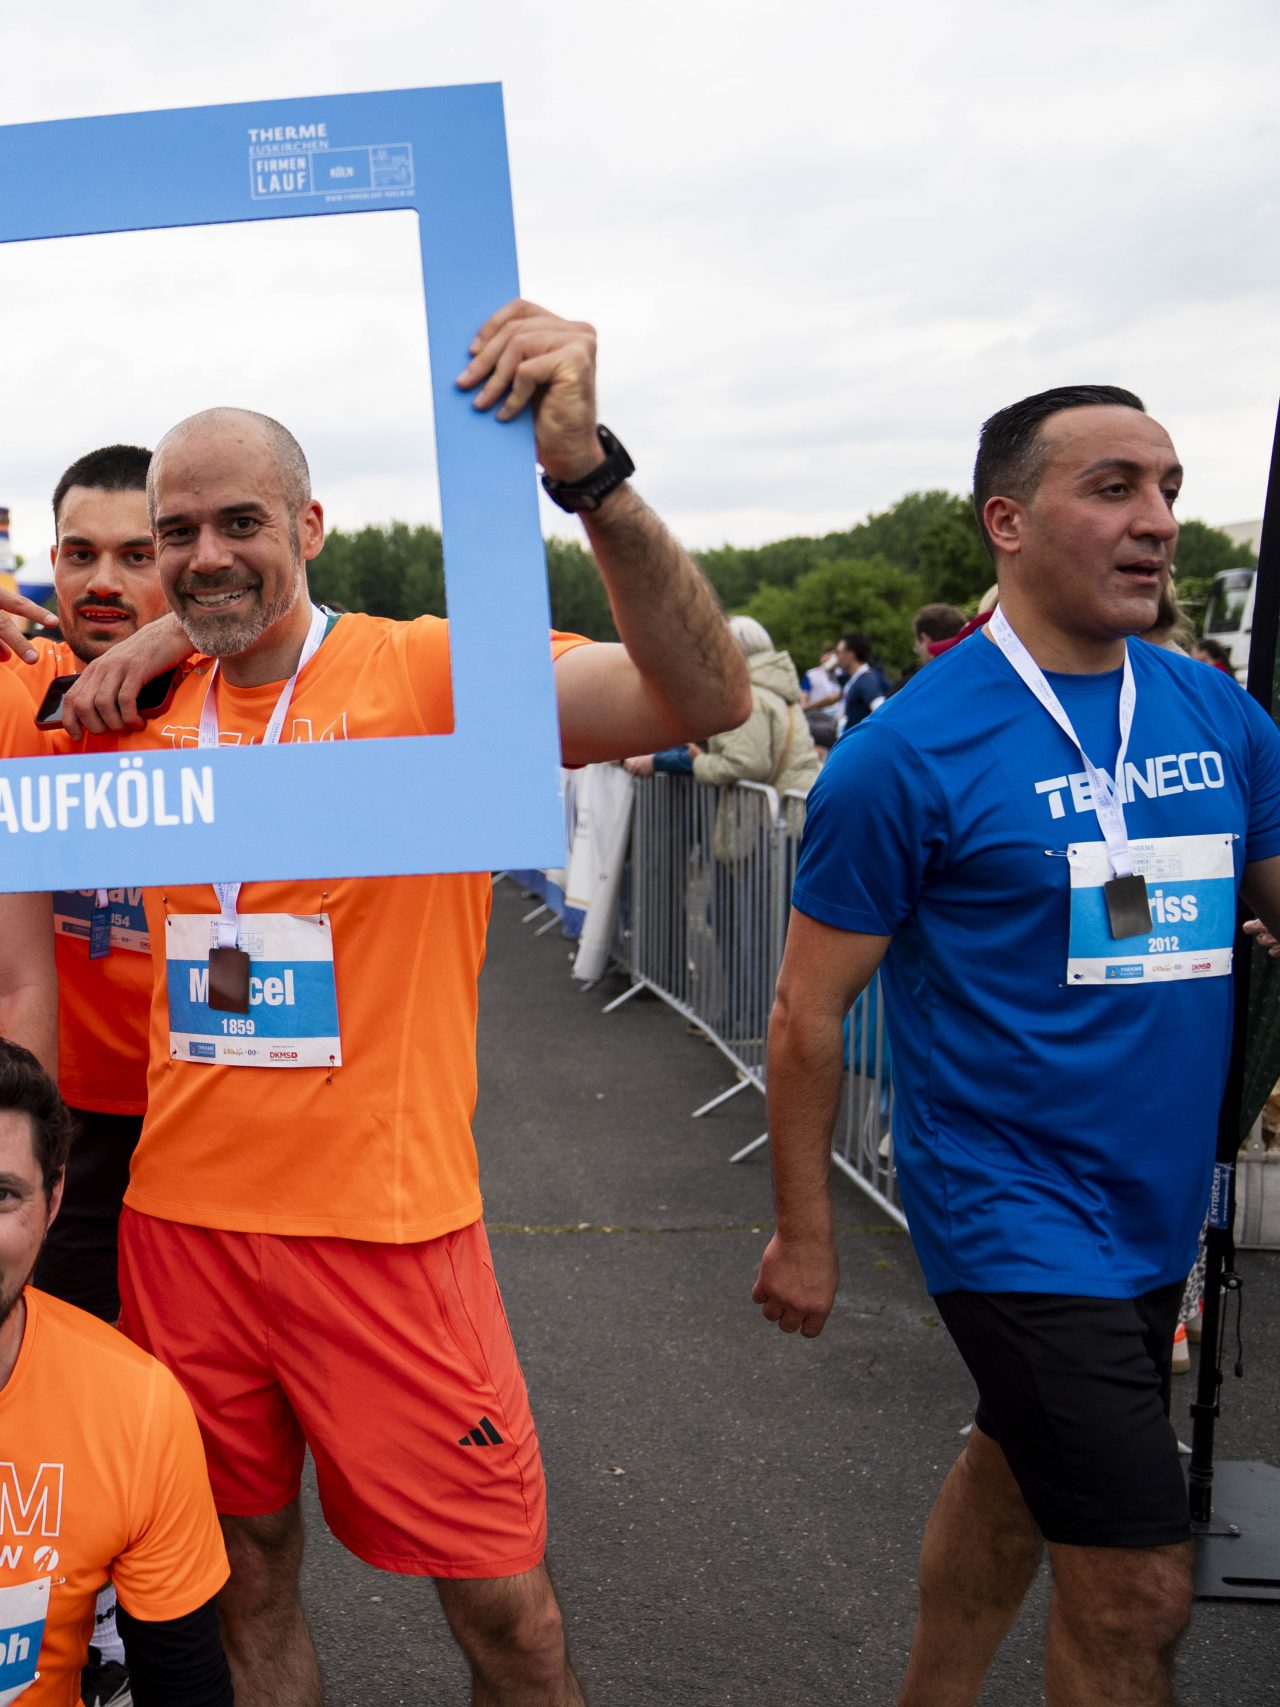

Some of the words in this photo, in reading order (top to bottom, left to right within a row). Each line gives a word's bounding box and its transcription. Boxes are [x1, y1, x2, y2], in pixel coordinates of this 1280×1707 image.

[248, 123, 327, 142] THERME
[256, 156, 306, 173] FIRMEN
[257, 172, 306, 193] LAUF
[1148, 889, 1198, 924] riss
[1148, 936, 1179, 953] 2012
[189, 968, 295, 1006] Mcel
[221, 1018, 255, 1035] 1859
[269, 1051, 291, 1059] DKMS
